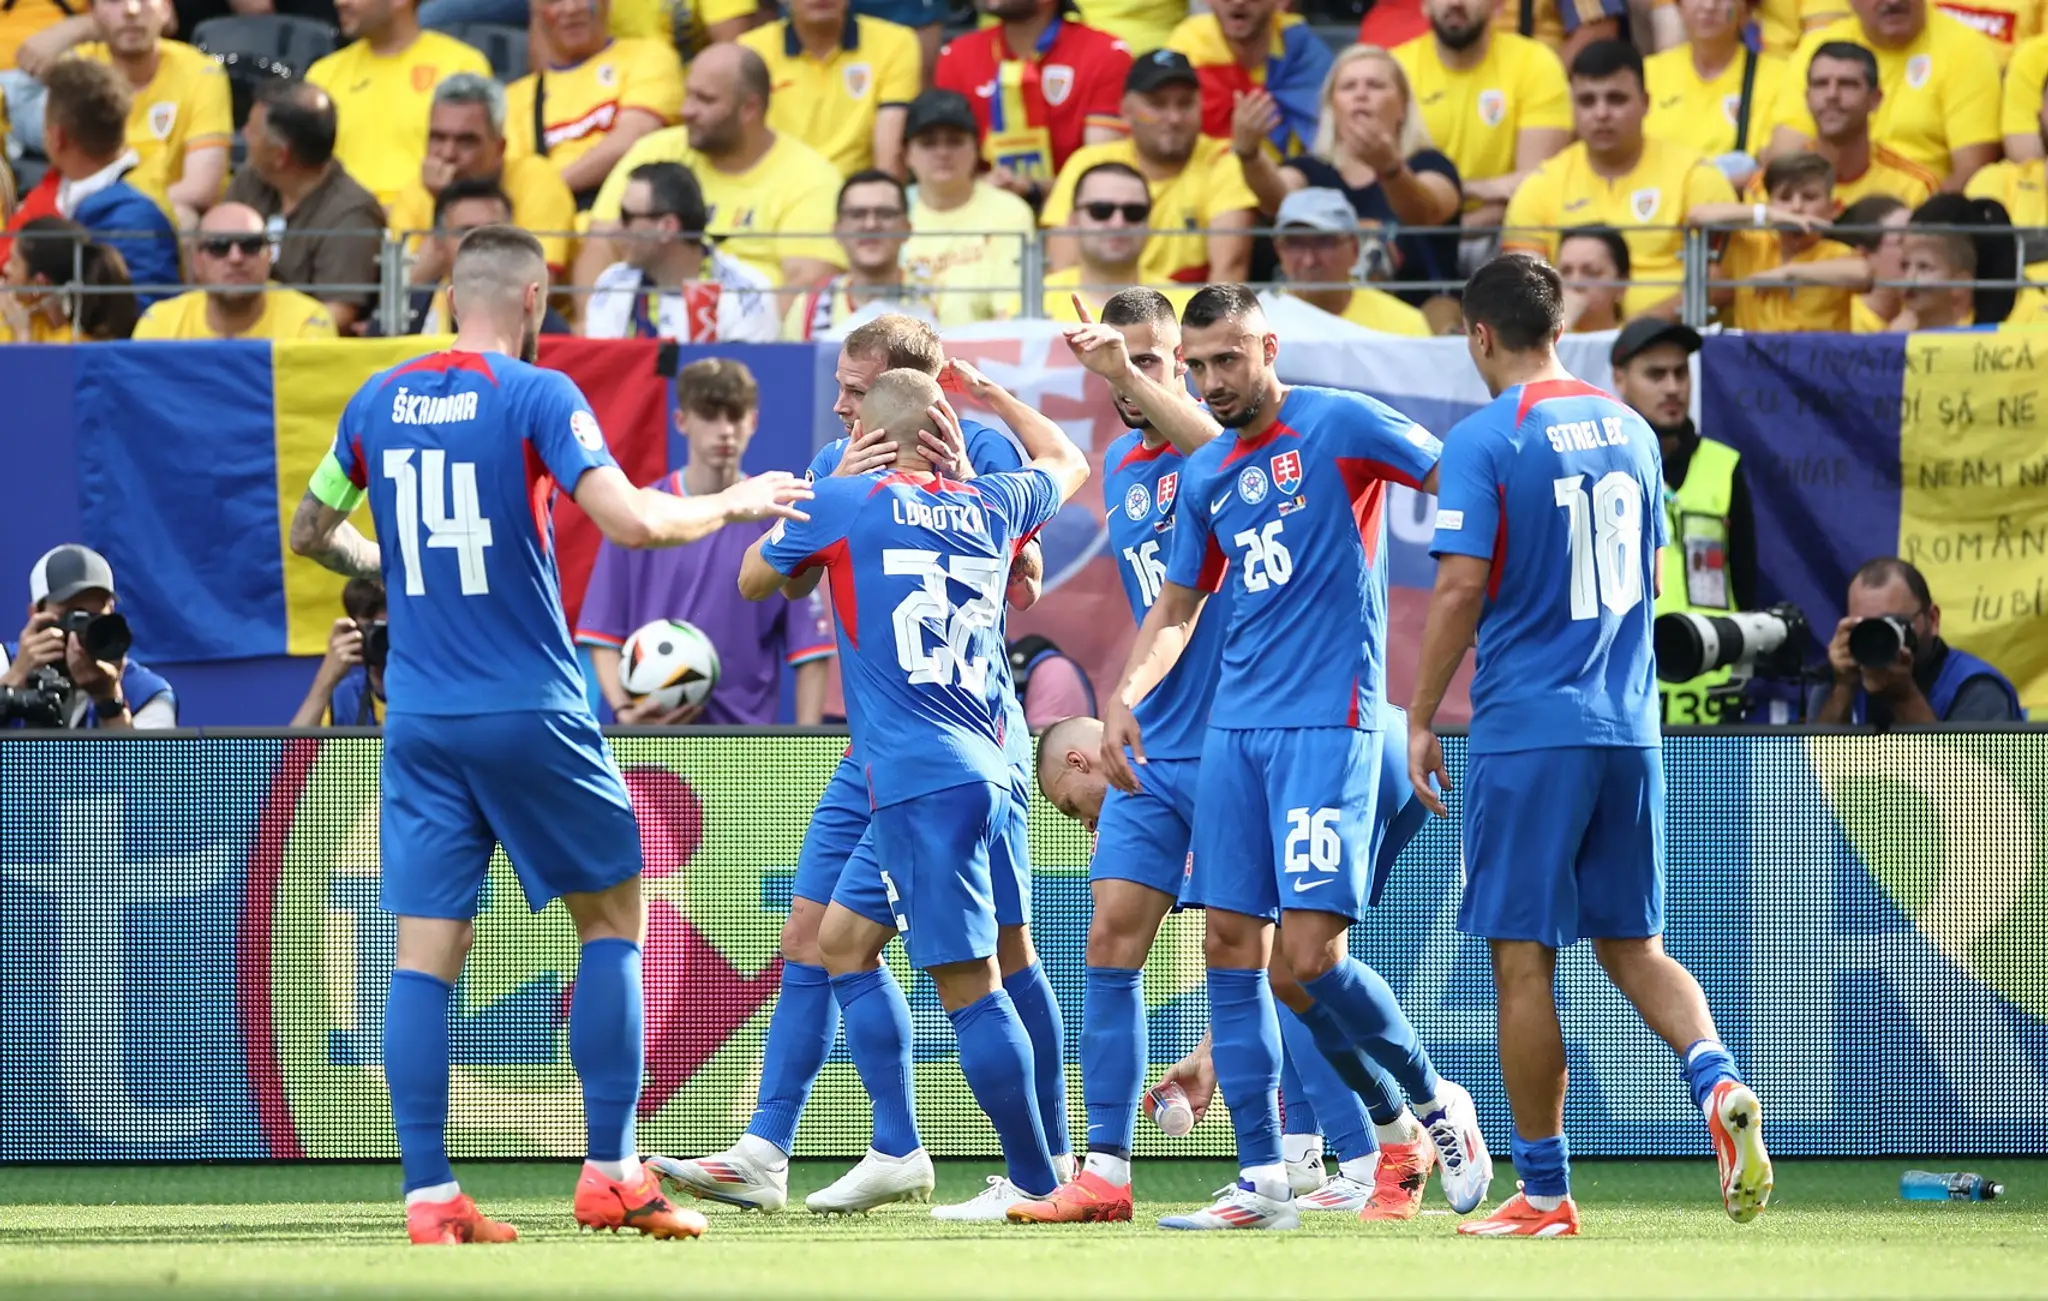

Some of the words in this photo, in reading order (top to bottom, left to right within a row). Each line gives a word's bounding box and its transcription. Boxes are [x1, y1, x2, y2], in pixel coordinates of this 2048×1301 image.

[1546, 416, 1629, 453] STRELEC
[1998, 390, 2039, 426] NE
[1920, 459, 2003, 489] NEAM
[383, 448, 493, 597] 14
[893, 499, 986, 532] LOBOTKA
[1553, 471, 1643, 621] 18
[1123, 539, 1166, 607] 16
[1234, 520, 1292, 593] 26
[883, 549, 1001, 699] 22
[1284, 807, 1341, 873] 26
